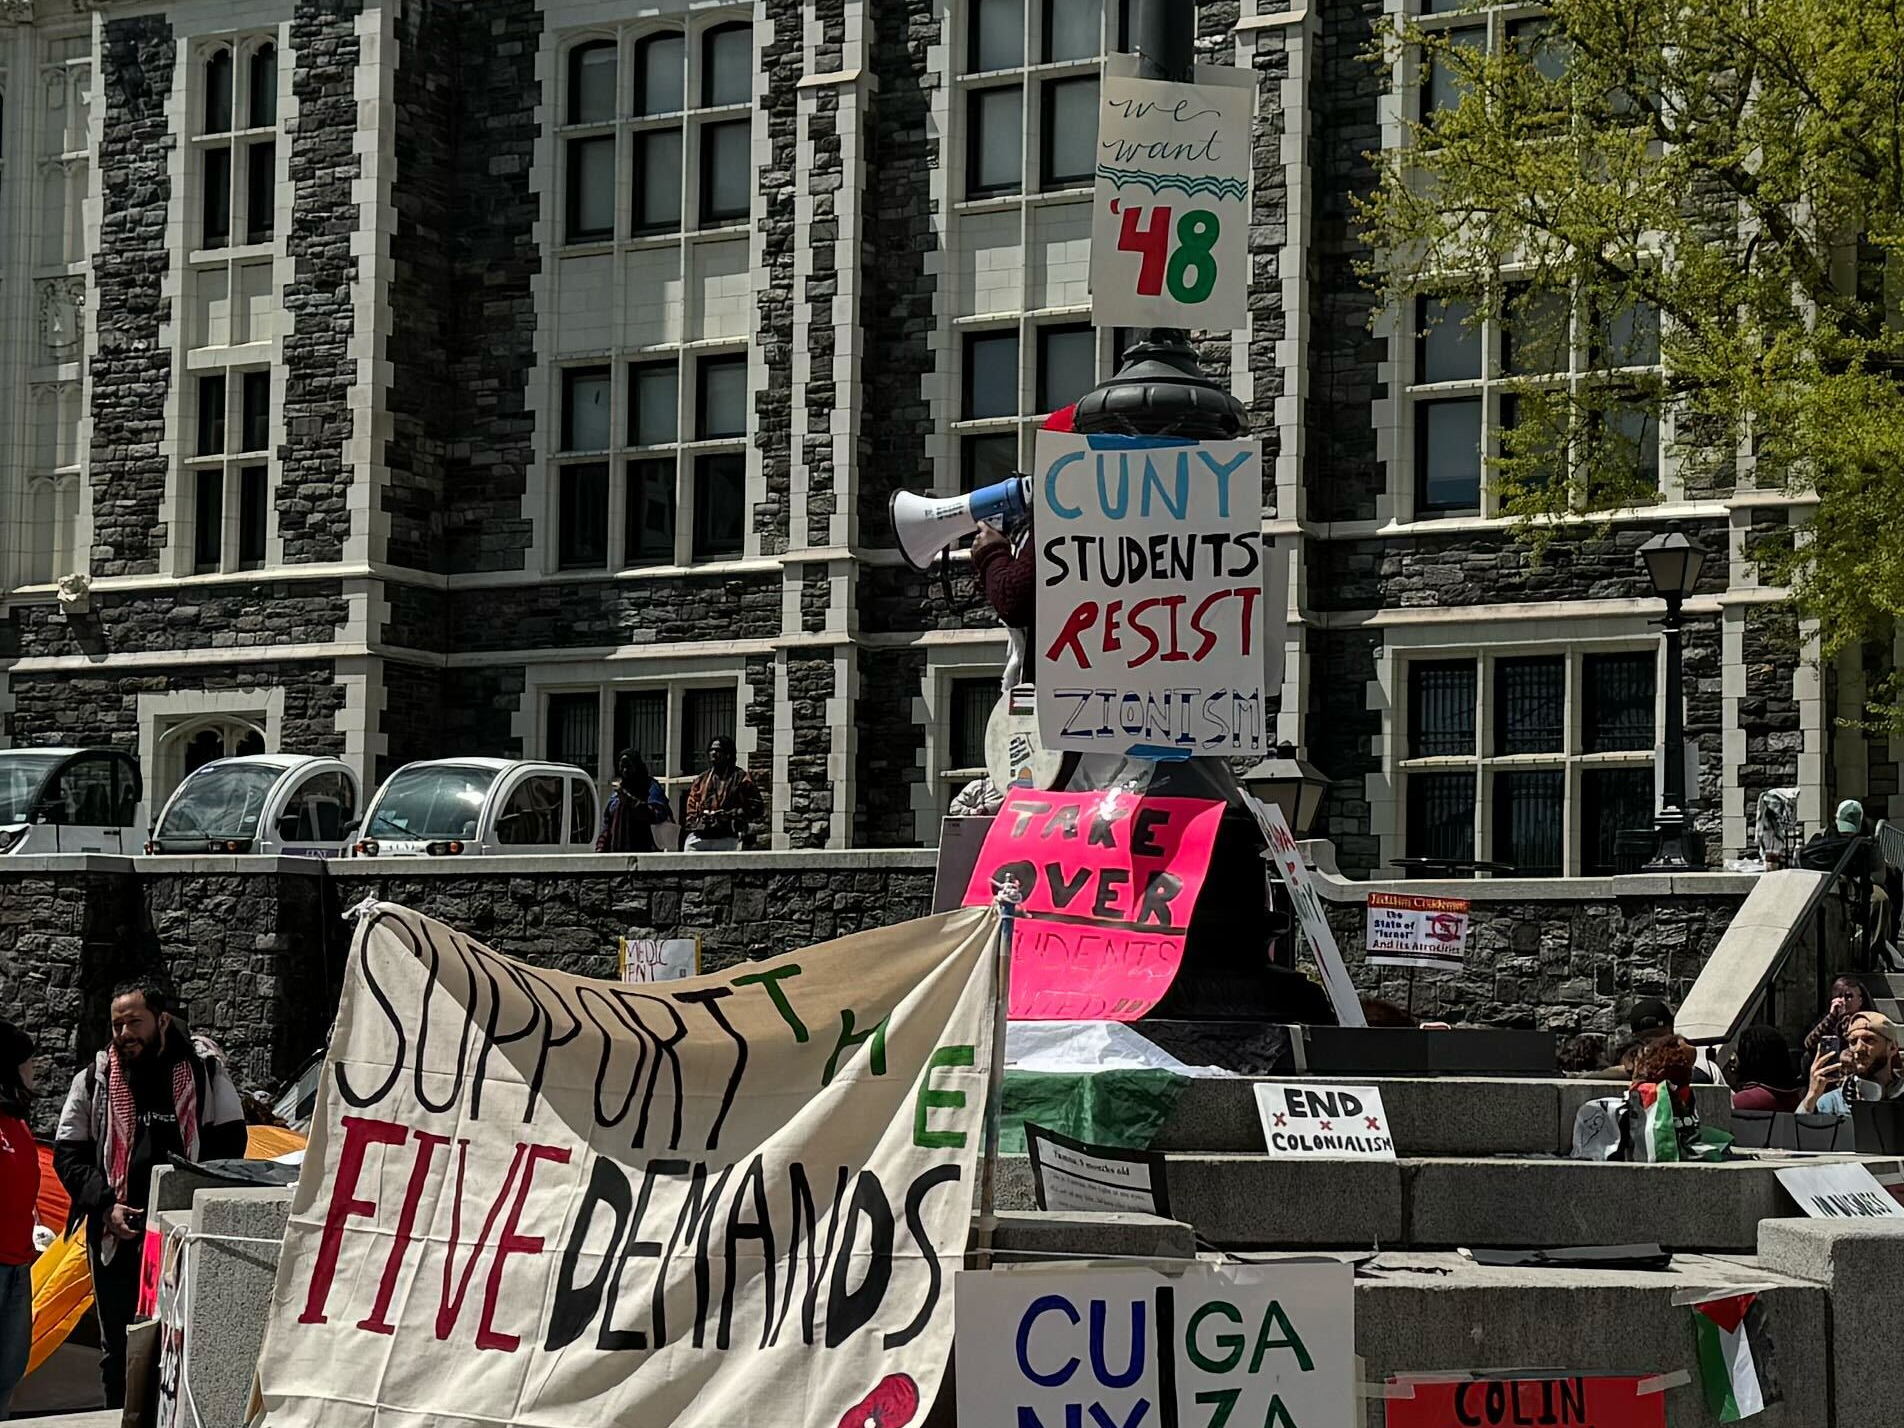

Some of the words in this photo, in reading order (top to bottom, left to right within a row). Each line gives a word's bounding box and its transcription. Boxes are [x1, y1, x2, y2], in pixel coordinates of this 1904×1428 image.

[1109, 96, 1221, 122] we
[1103, 137, 1221, 162] want
[1044, 450, 1254, 520] CUNY
[1044, 531, 1260, 587] STUDENTS
[1045, 586, 1262, 669] RESIST
[1053, 687, 1261, 750] ZIONISM
[1007, 798, 1173, 860] TAKE
[990, 859, 1183, 927] OVER
[1373, 940, 1393, 949] And
[1374, 920, 1402, 928] State
[336, 910, 748, 1150] SUPPORT
[731, 963, 976, 1150] THE
[1283, 1087, 1364, 1118] END
[1271, 1132, 1393, 1153] COLONIALISM
[298, 1116, 573, 1352] FIVE
[543, 1154, 962, 1352] DEMANDS
[1016, 1294, 1146, 1389] CU
[1185, 1300, 1315, 1374] GA
[1454, 1376, 1586, 1427] COLIN
